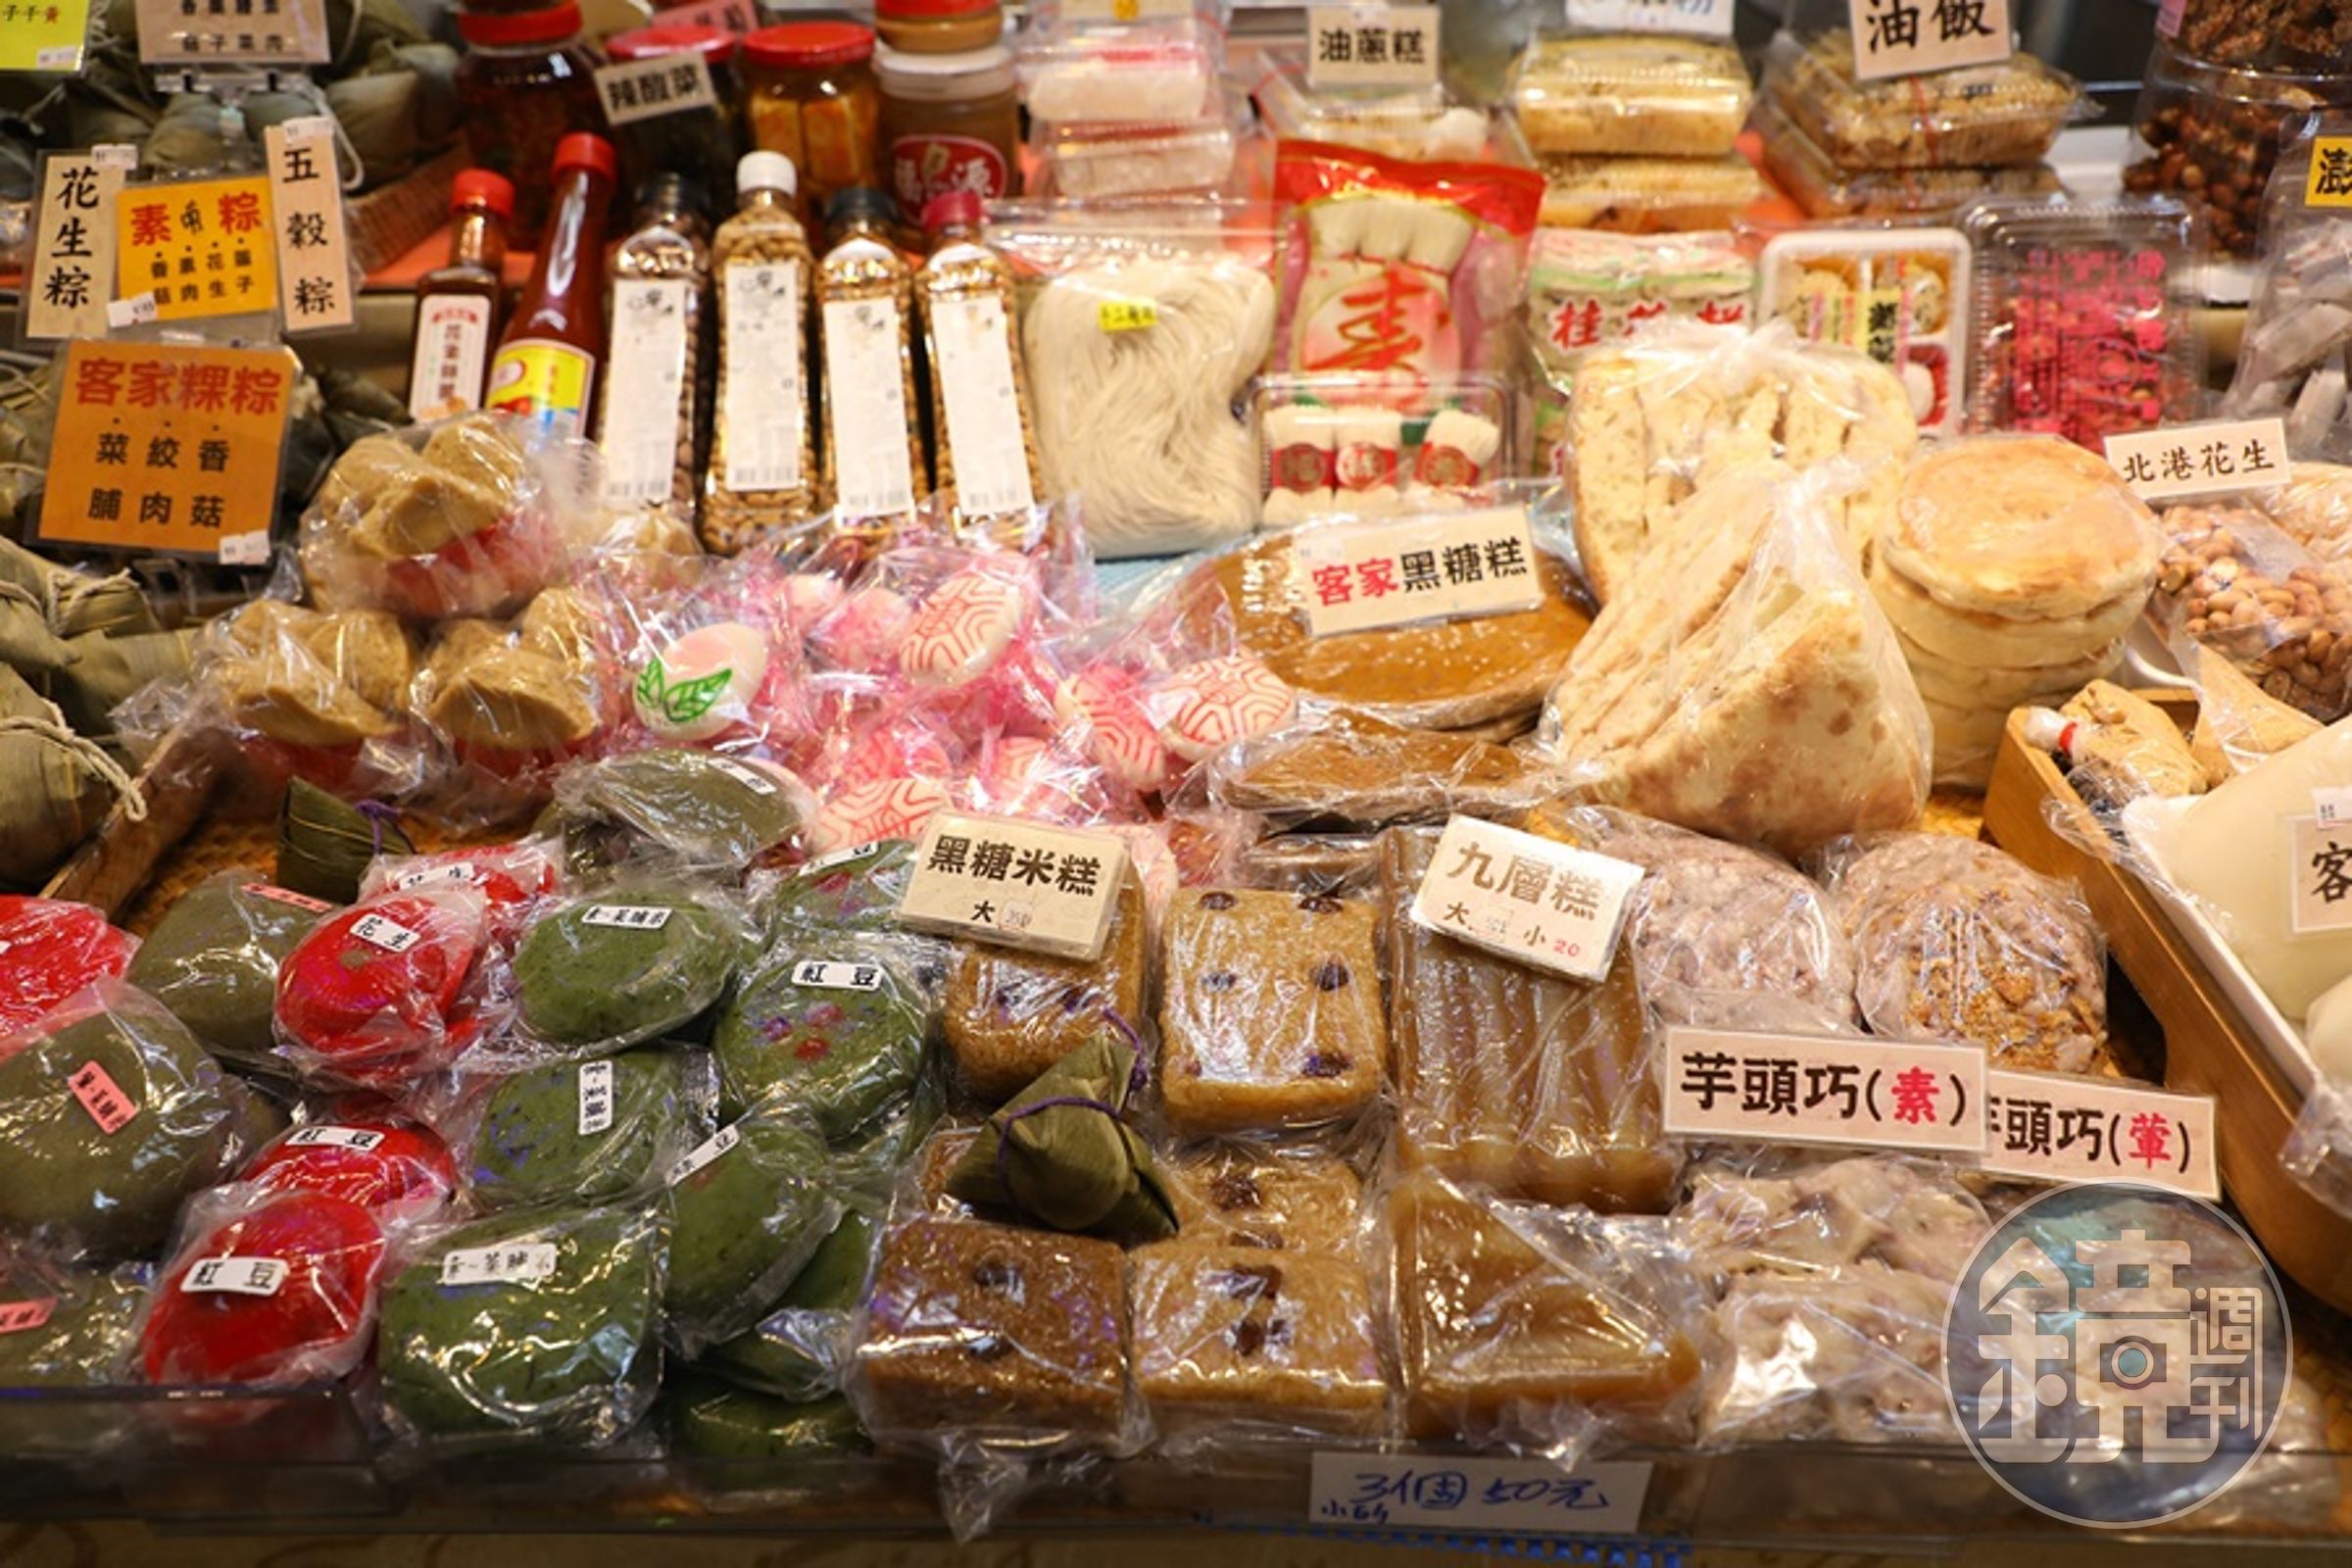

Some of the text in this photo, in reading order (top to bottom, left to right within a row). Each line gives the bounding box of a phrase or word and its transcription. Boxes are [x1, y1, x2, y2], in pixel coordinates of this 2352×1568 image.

[1865, 0, 1995, 54] 油飯
[43, 165, 99, 309] 花生粽
[282, 147, 335, 315] 五穀粽
[75, 358, 282, 416] 客家粿粽
[2124, 439, 2275, 483] 北港花生
[1311, 537, 1527, 606] 客家黑糖糕
[926, 835, 1102, 897] 黑糖米糕
[1446, 842, 1602, 921] 九層糕
[971, 900, 996, 923] 大
[1444, 902, 1469, 925] 大
[1523, 925, 1546, 947] 小
[1552, 940, 1581, 957] 20
[799, 963, 878, 986] 紅豆
[1682, 1052, 1967, 1127] 芋頭巧(素)
[1990, 1096, 2190, 1174] 頭巧(葷)
[193, 1261, 280, 1289] 紅豆
